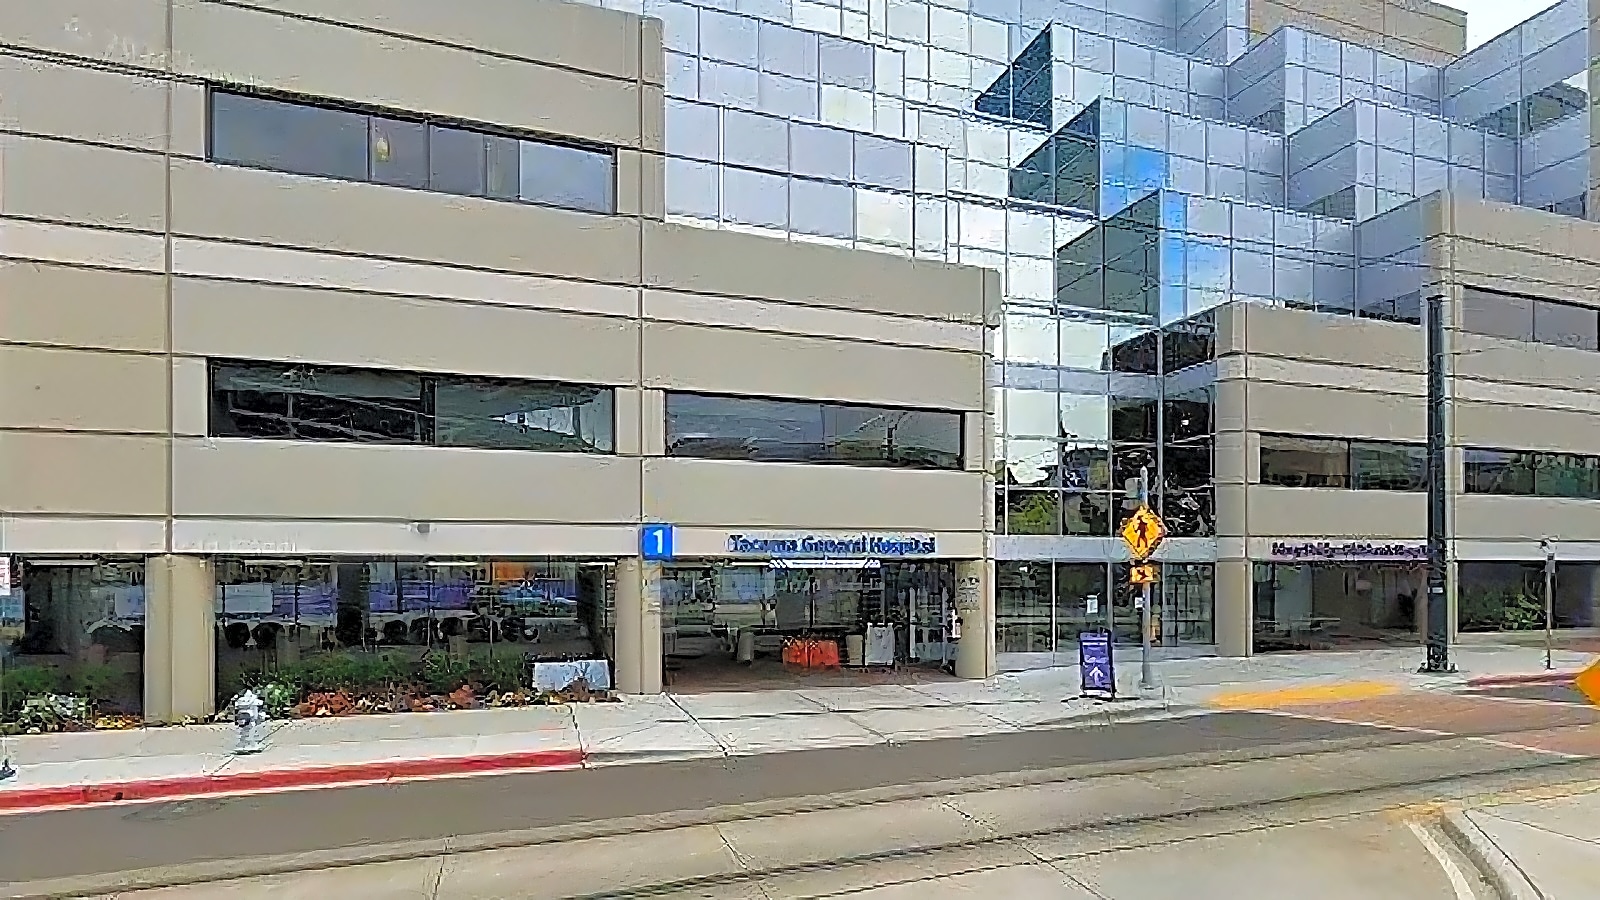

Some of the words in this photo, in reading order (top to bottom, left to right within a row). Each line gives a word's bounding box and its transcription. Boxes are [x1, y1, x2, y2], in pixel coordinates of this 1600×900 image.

[653, 529, 663, 554] 1
[801, 534, 867, 553] General
[869, 536, 935, 555] Hospital
